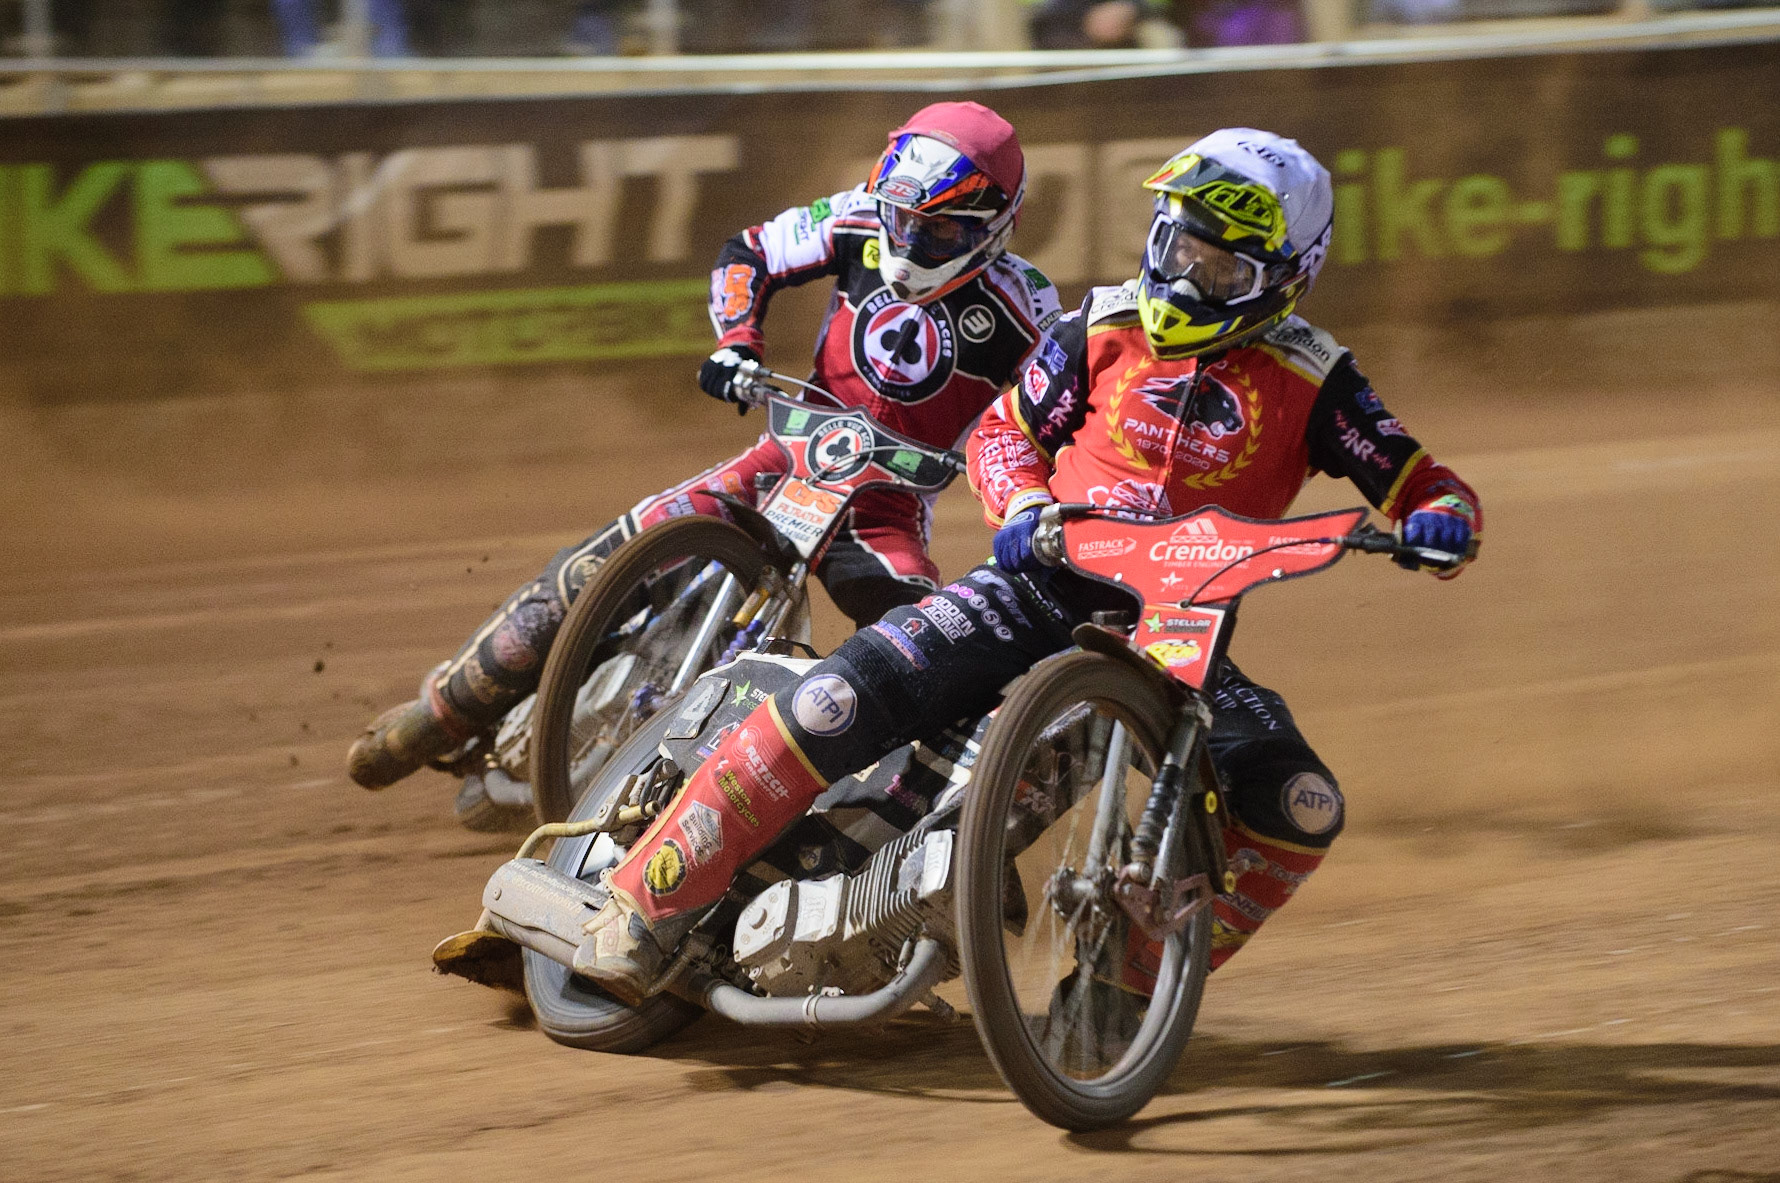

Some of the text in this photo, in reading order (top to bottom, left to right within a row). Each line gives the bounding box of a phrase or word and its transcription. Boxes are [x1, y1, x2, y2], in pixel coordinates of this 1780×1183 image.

[0, 135, 740, 295] KERIGHT
[1335, 128, 1780, 275] ike-righ
[818, 420, 843, 437] BELLE
[1124, 418, 1231, 463] PANTHERS
[766, 510, 824, 537] PREMIER
[1079, 539, 1124, 552] FASTRACK
[1149, 539, 1254, 562] Crendon
[1166, 619, 1212, 627] STELLAR
[807, 686, 843, 723] ATPI
[718, 775, 760, 827] Motorcycles
[726, 770, 751, 805] Weston
[1293, 790, 1333, 813] ATPI
[689, 813, 713, 850] Building
